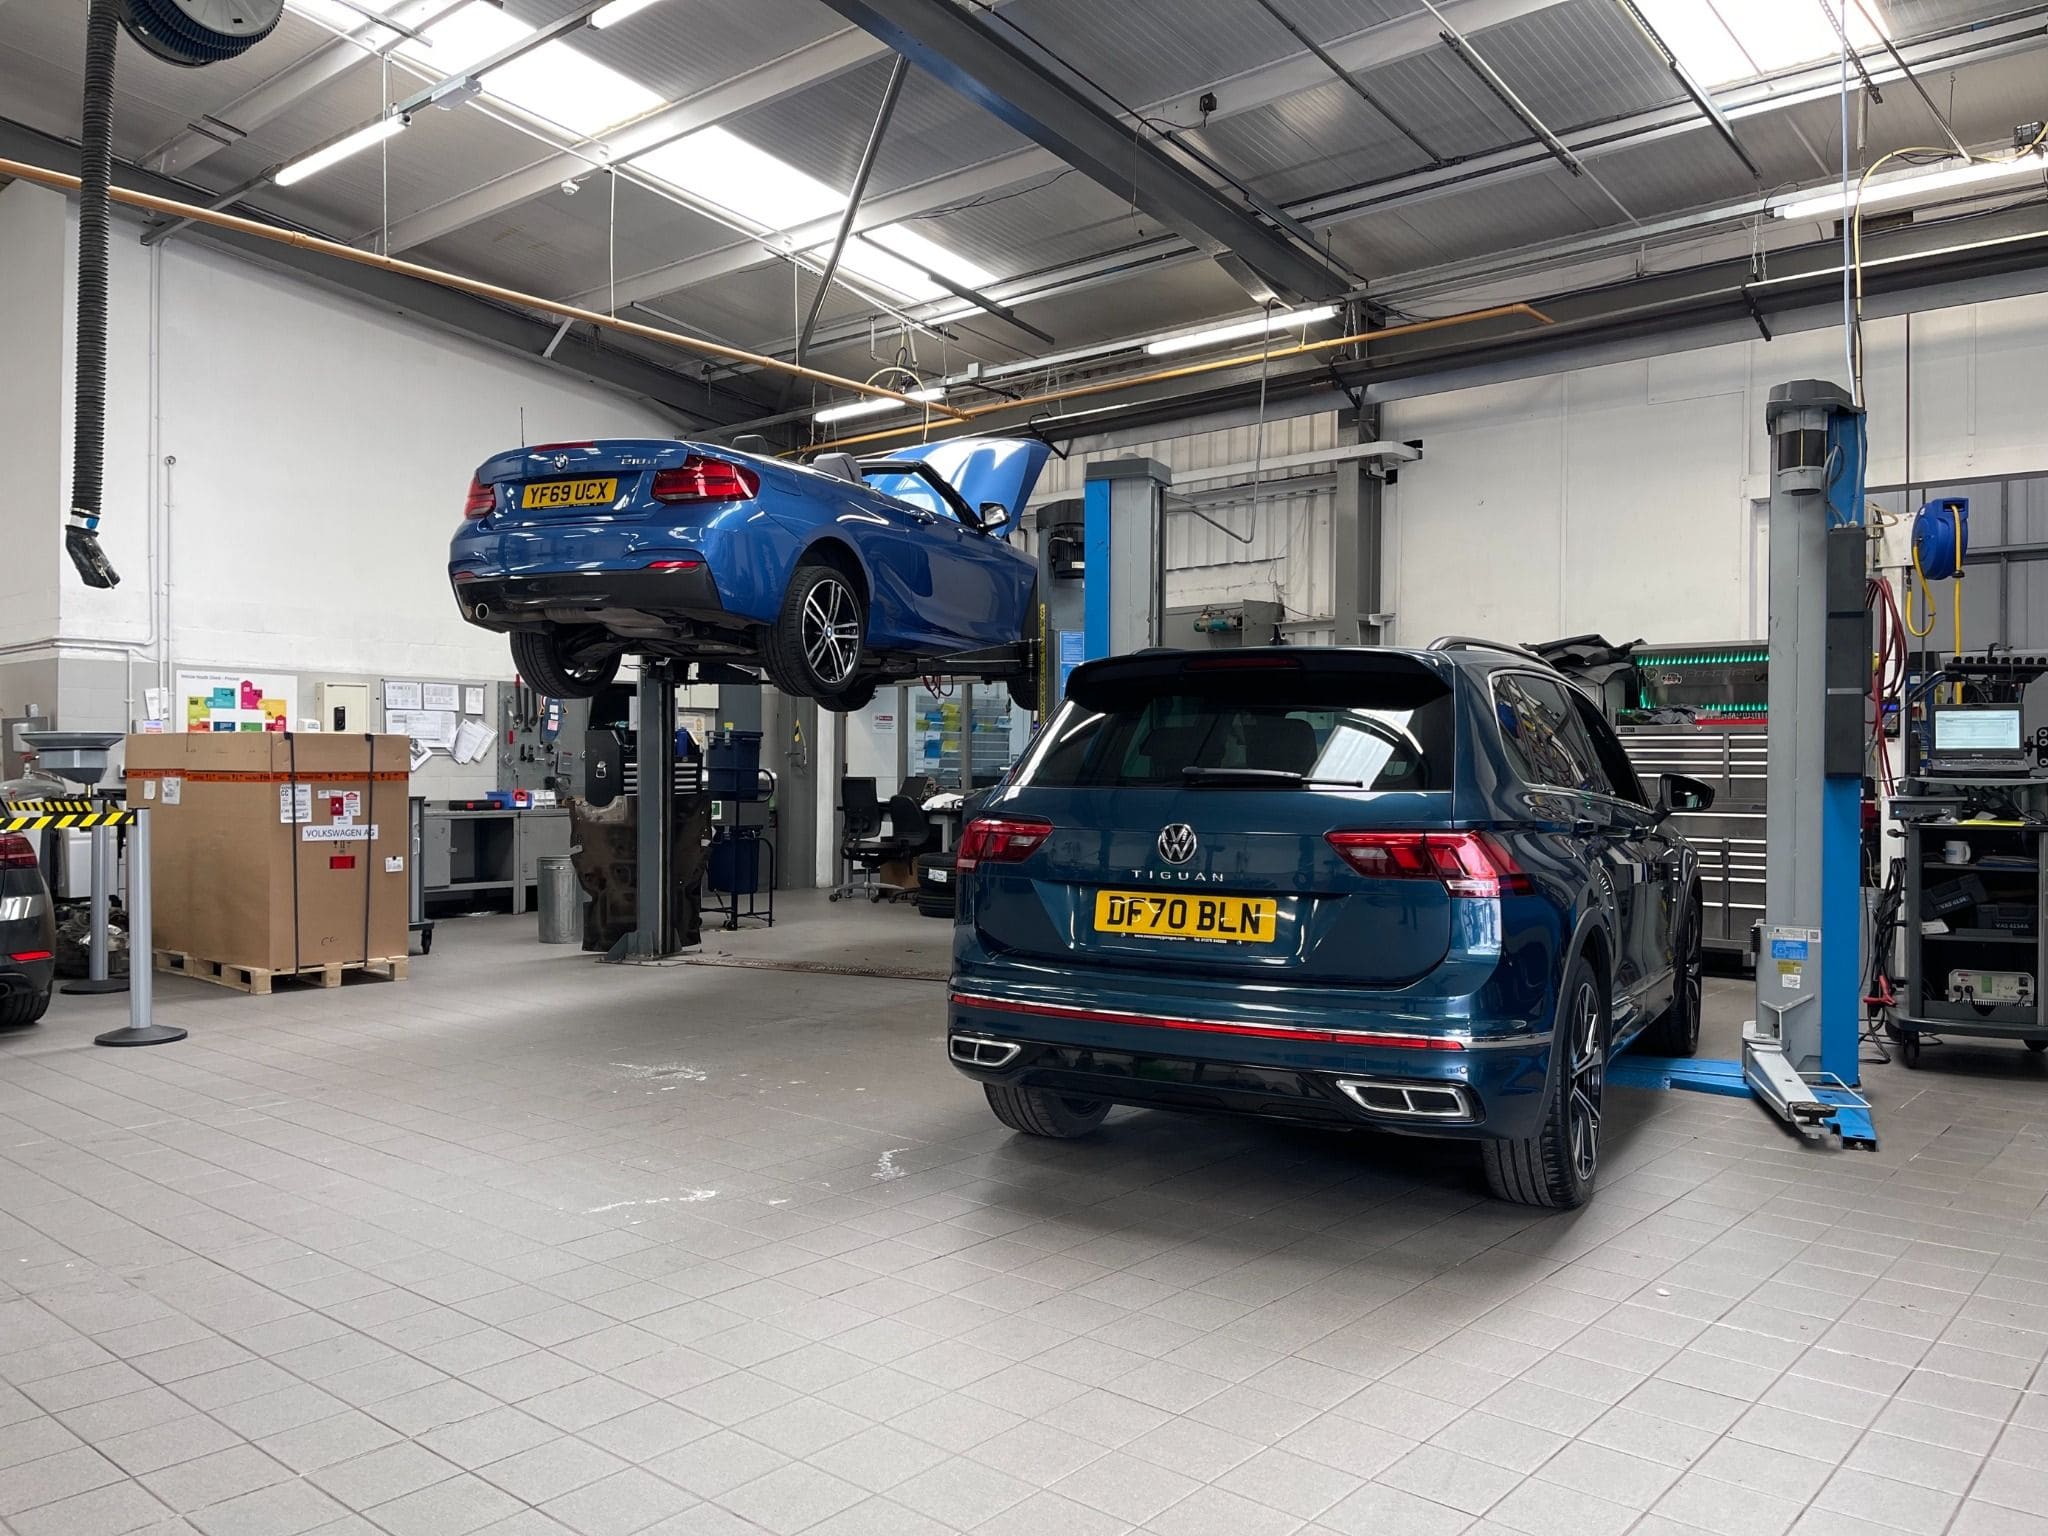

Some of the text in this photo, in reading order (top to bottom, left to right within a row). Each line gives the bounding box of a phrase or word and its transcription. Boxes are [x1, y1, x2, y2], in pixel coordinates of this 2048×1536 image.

[530, 481, 608, 504] YF69 UCX
[305, 827, 375, 838] VOLKSWAGEN AG
[1131, 869, 1224, 882] TIGUAN
[1107, 895, 1261, 935] DF70 BLN
